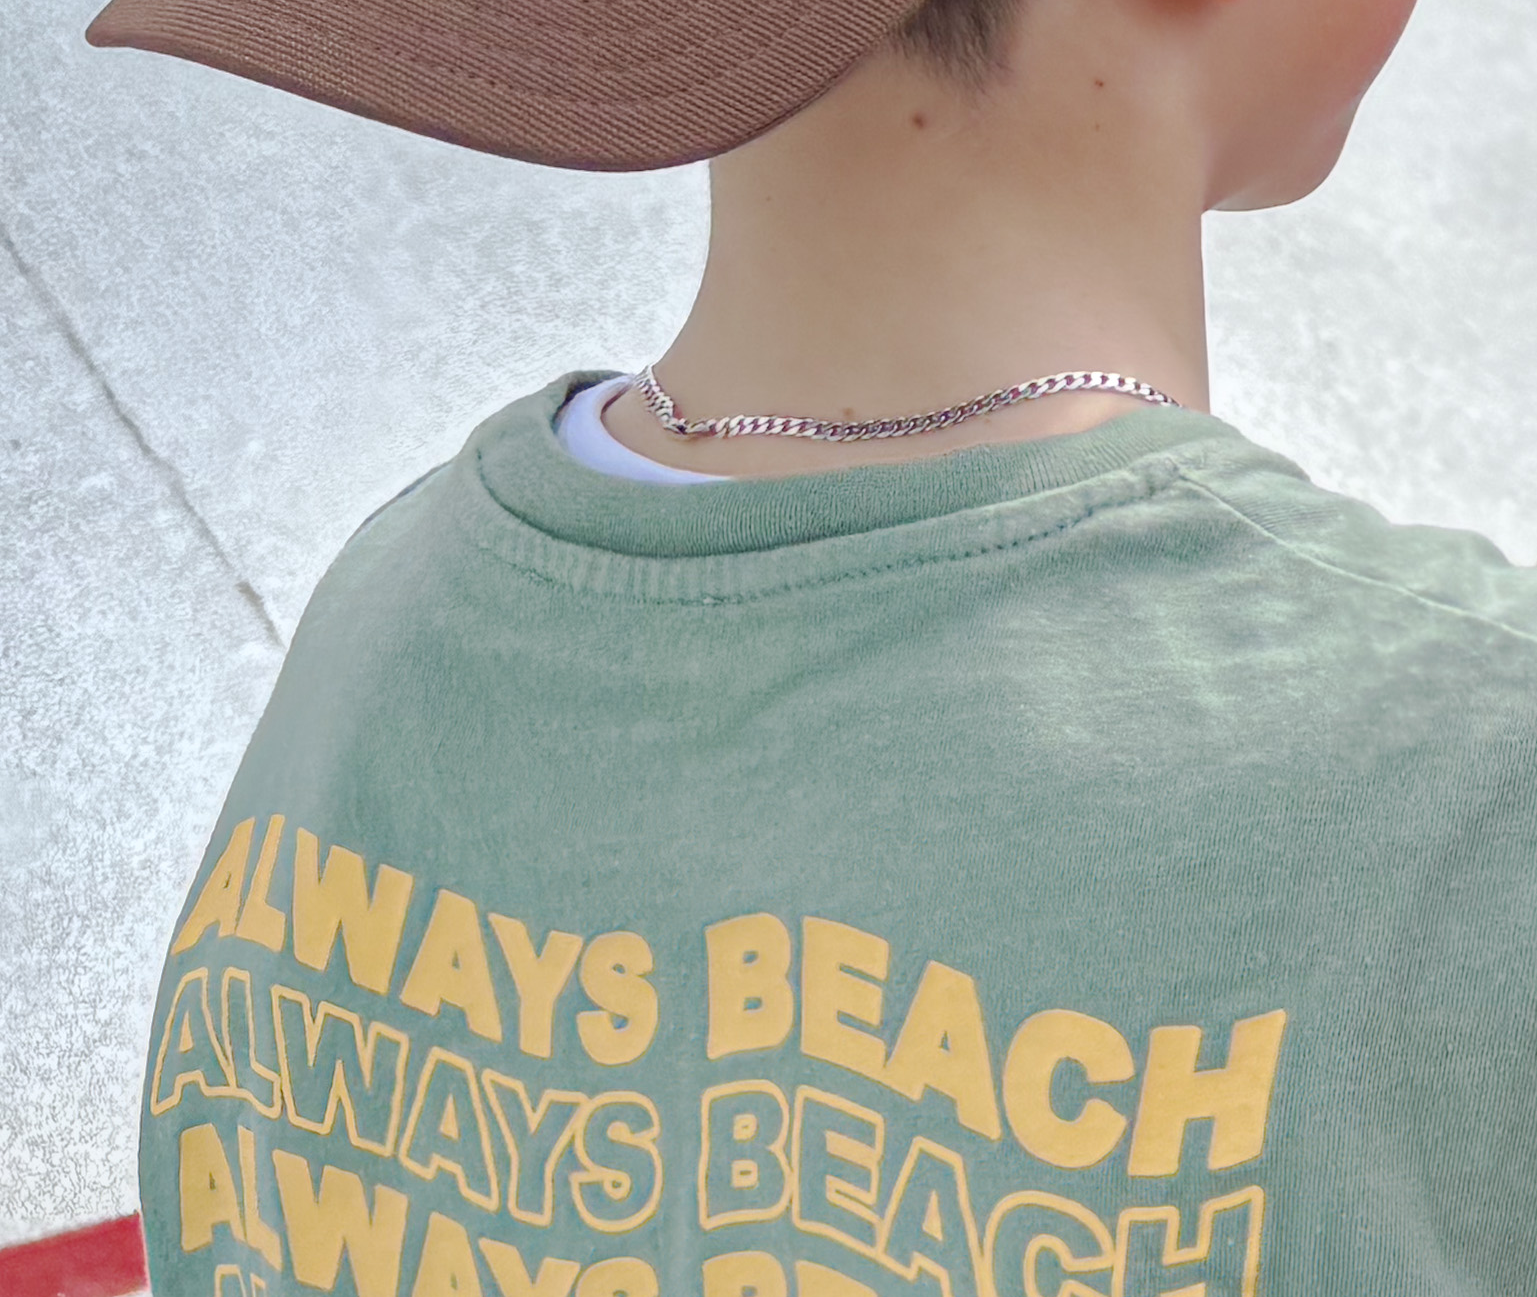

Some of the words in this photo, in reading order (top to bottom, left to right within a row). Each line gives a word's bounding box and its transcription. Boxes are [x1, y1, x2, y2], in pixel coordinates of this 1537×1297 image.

[151, 966, 662, 1234] ALWAYS
[698, 1079, 1265, 1297] BEACH
[170, 813, 658, 1065] ALWAYS
[705, 910, 1287, 1177] BEACH
[179, 1123, 659, 1297] ALWA
